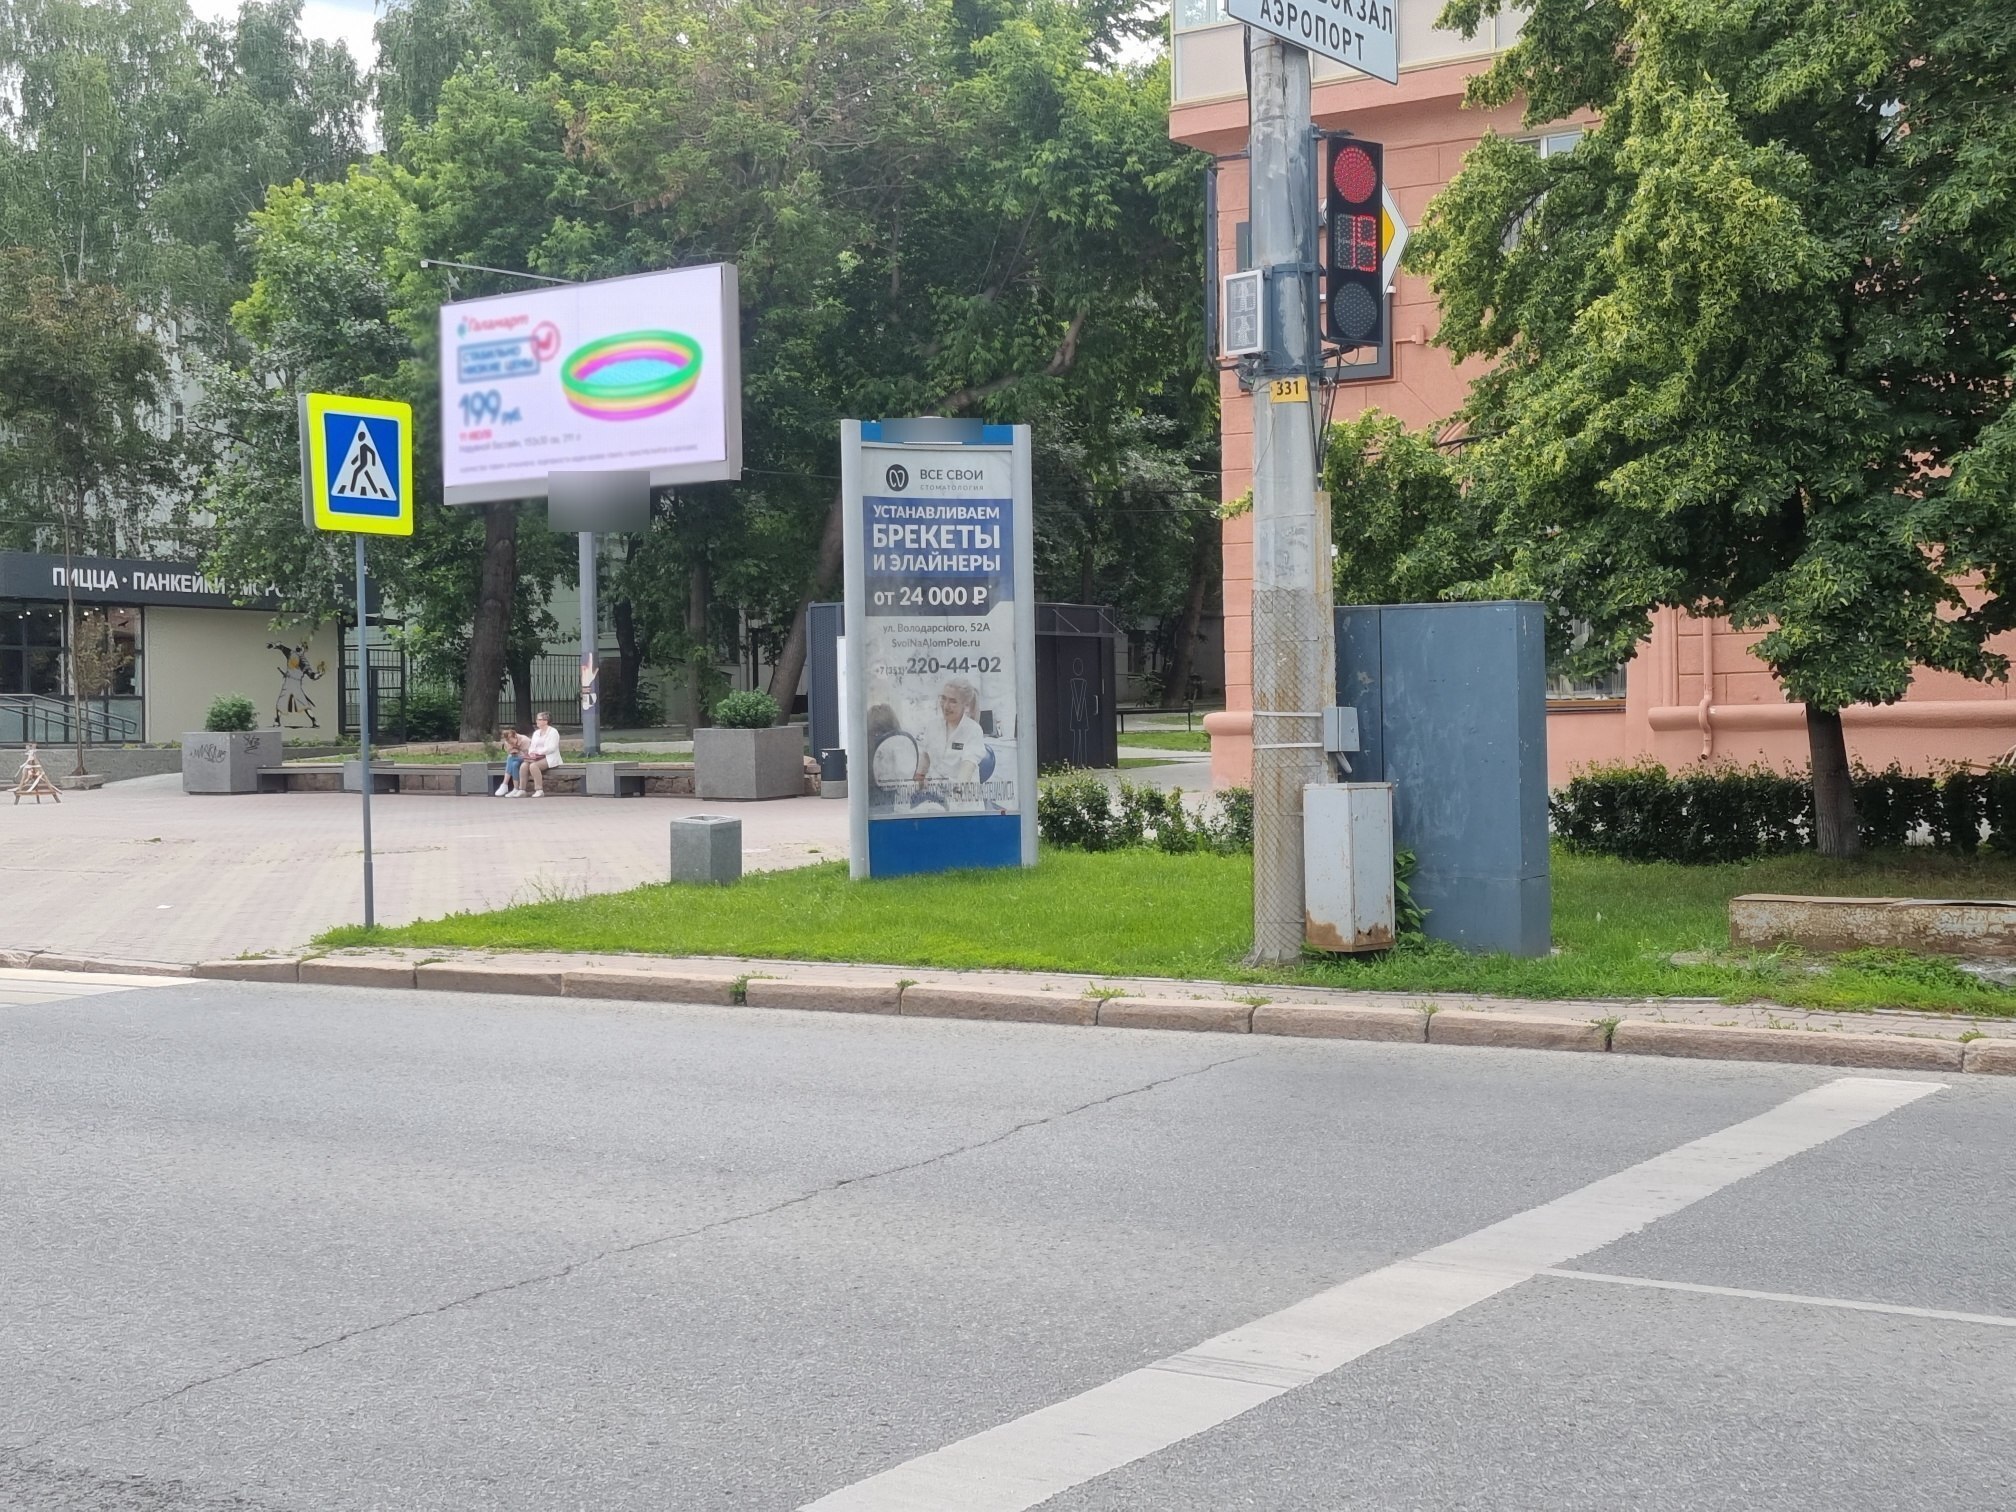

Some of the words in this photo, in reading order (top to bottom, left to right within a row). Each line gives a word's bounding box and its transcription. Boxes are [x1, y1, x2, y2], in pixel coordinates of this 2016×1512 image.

[1261, 0, 1364, 61] АЭРОПОРТ
[1276, 380, 1300, 395] 331
[459, 389, 502, 427] 199
[920, 469, 943, 480] ВСЕ
[946, 469, 984, 481] СВОИ
[873, 505, 1000, 520] УСТАНАВЛИВАЕМ
[873, 524, 1000, 549] БРЕКЕТЫ
[873, 554, 885, 571] И
[890, 551, 1001, 571] ЭЛАЙНЕРЫ
[52, 567, 119, 592] ПИЦЦА
[874, 591, 895, 605] от
[900, 586, 923, 606] 24
[928, 586, 967, 606] 000
[883, 624, 895, 634] ул.
[897, 623, 968, 635] Володарского,
[970, 623, 990, 632] 52А
[906, 656, 1002, 675] 220-44-02
